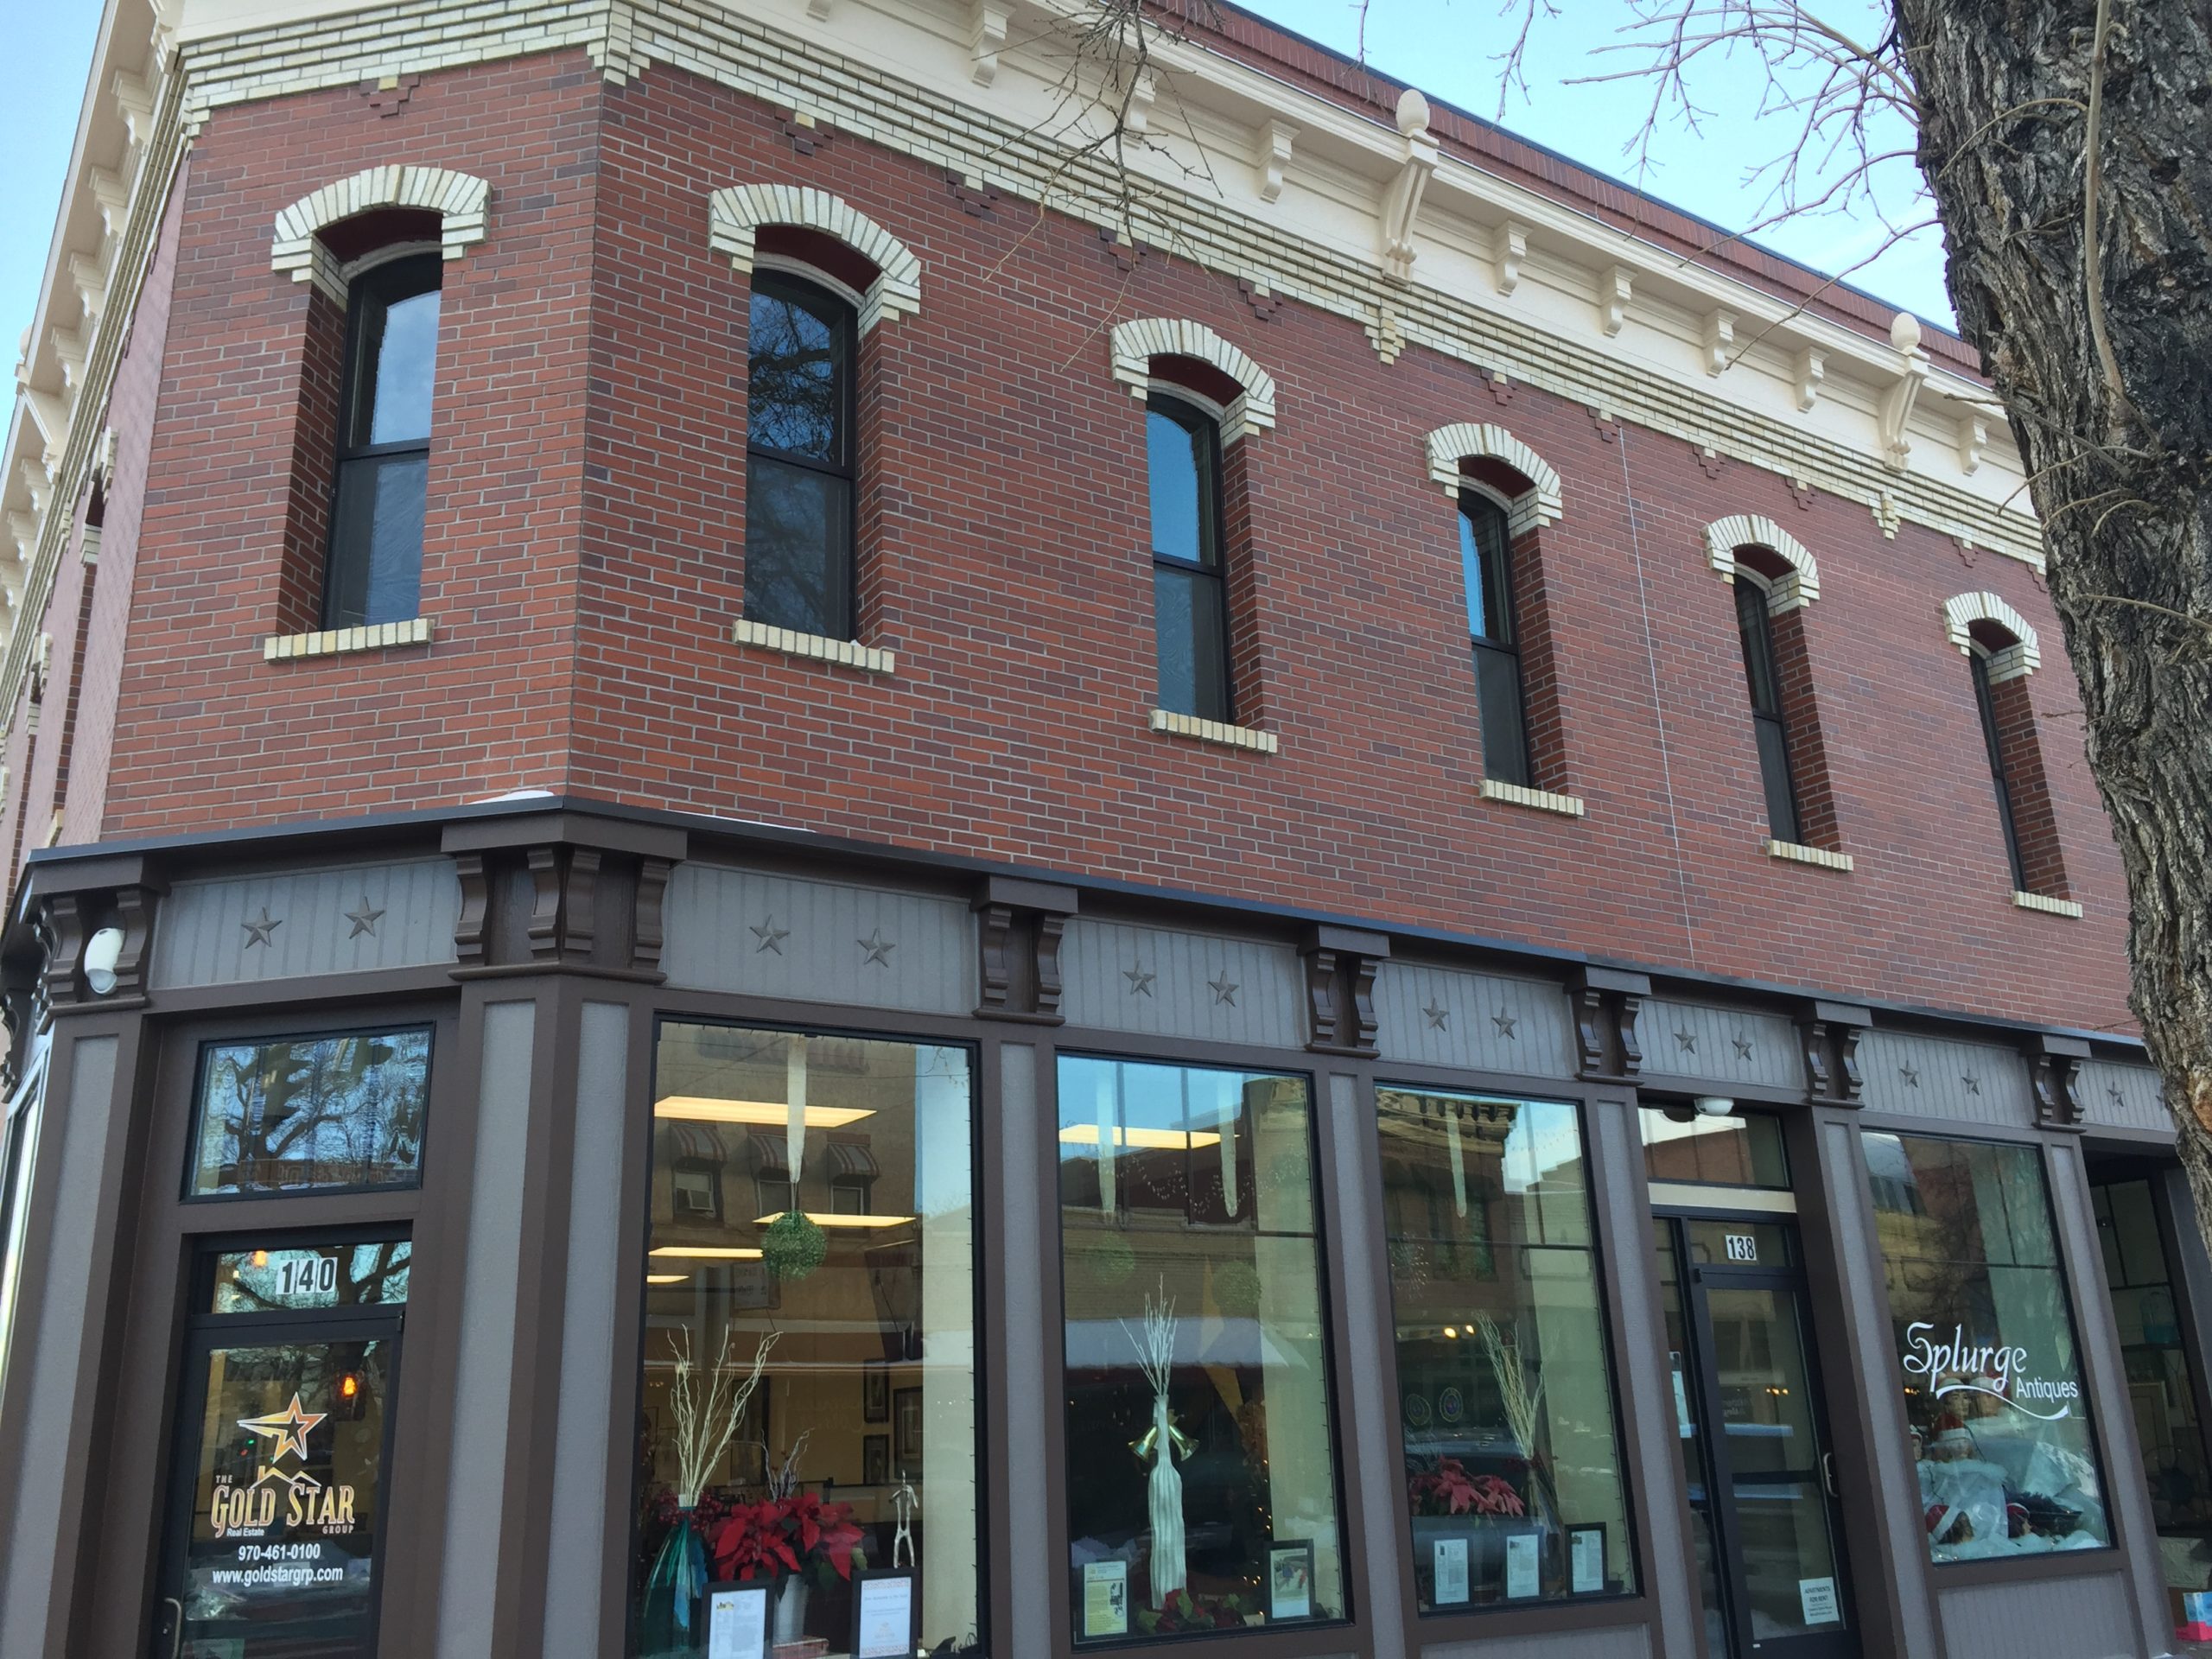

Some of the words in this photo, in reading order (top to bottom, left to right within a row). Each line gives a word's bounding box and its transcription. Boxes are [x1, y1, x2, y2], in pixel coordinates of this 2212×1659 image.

[1728, 1236, 1754, 1259] 138
[283, 1259, 334, 1293] 140
[1904, 1322, 2027, 1392] Splurge
[2016, 1376, 2078, 1403] Antiques
[216, 1474, 232, 1484] THE
[211, 1484, 276, 1538] GOLD
[286, 1483, 355, 1527] STAR
[226, 1528, 241, 1536] Real
[243, 1527, 264, 1536] Estate
[322, 1525, 353, 1534] GROUP
[238, 1543, 321, 1561] 970-461-0100
[213, 1565, 344, 1587] www.goldstargrp.com
